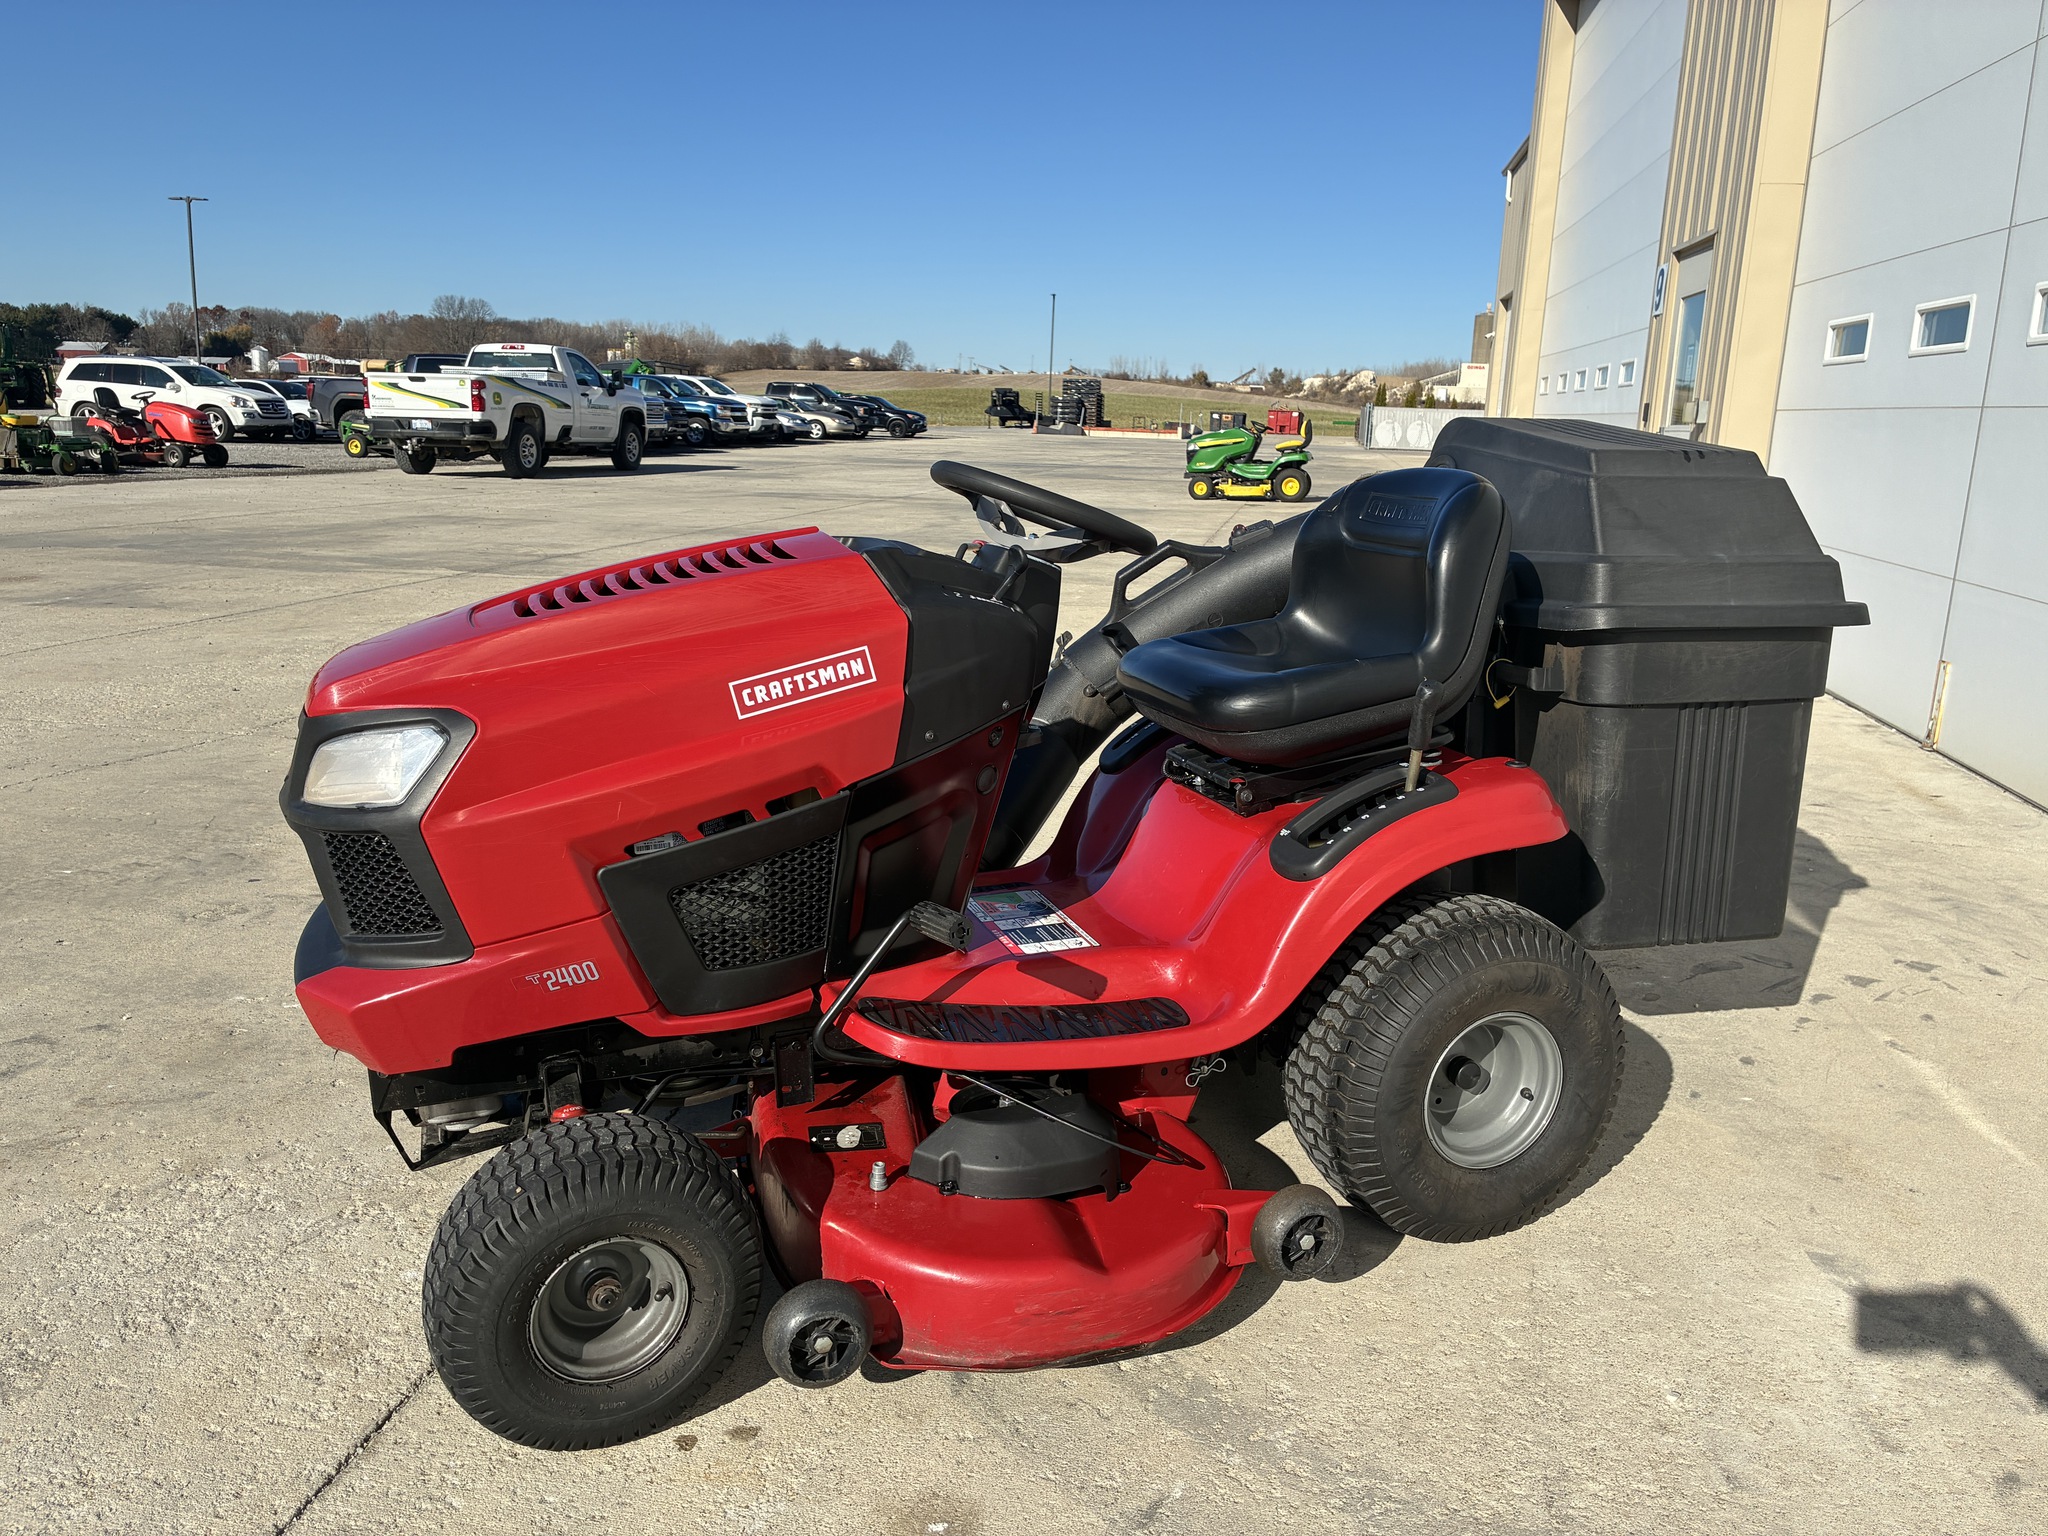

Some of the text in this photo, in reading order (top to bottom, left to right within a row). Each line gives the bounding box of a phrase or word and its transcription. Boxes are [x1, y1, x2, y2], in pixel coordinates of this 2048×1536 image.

[1654, 267, 1665, 312] 9
[741, 657, 866, 707] CRAFTSMAN
[525, 961, 600, 991] T2400
